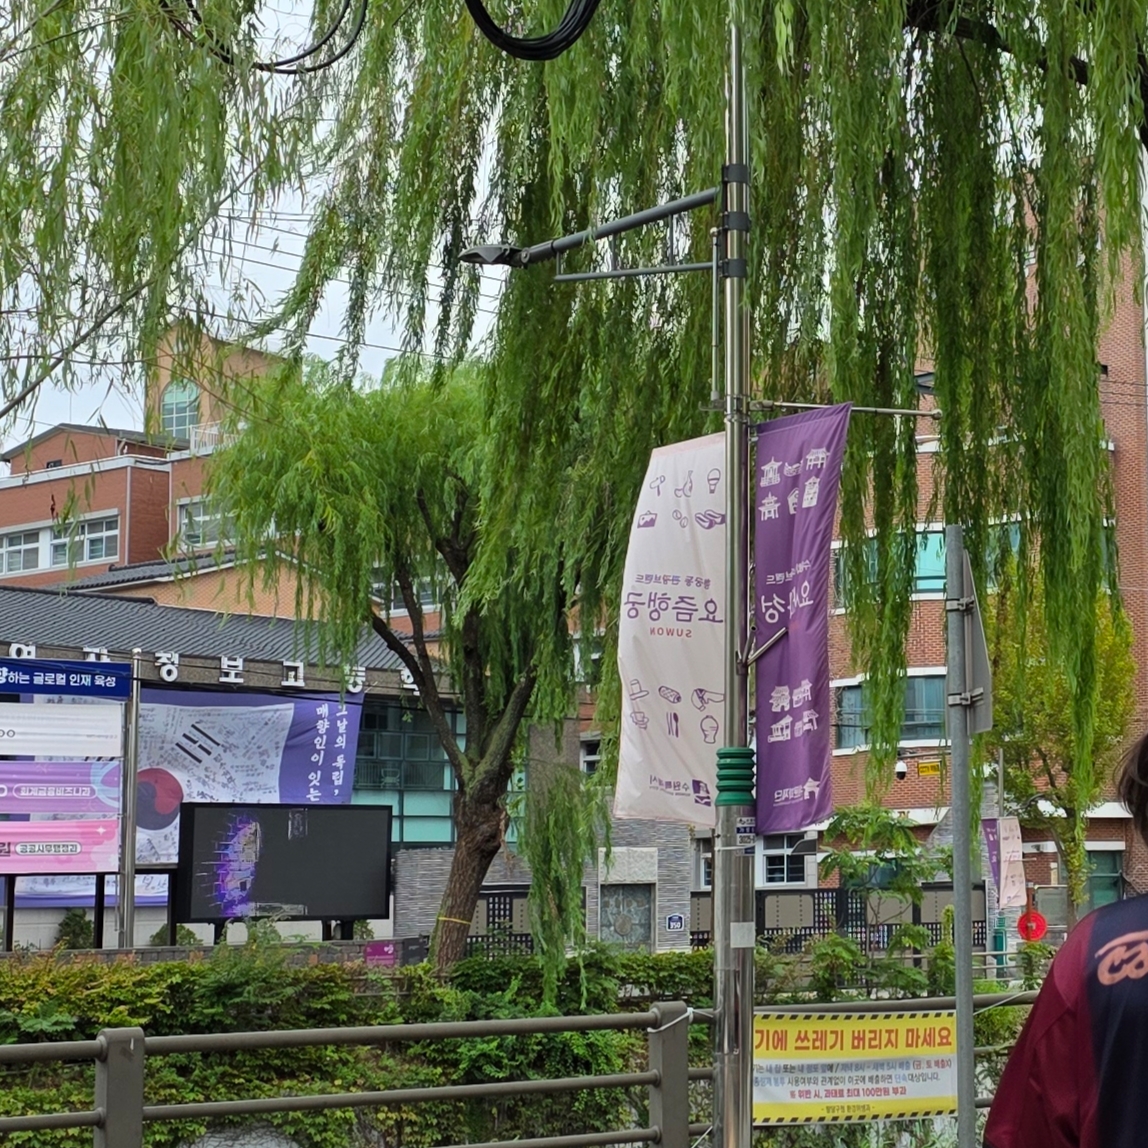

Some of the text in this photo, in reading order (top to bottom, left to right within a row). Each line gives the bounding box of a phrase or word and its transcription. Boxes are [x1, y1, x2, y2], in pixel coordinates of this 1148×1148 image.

[33, 672, 66, 685] 글로컬
[69, 673, 91, 686] 인재
[94, 675, 116, 687] 육성
[306, 703, 330, 801] 매향인이 잇는
[794, 1029, 844, 1051] 쓰레기
[851, 1028, 898, 1050] 버리지
[905, 1026, 952, 1048] 마세요
[783, 1064, 796, 1074] 또는
[862, 1086, 890, 1097] 100만원
[892, 1086, 906, 1096] 부과
